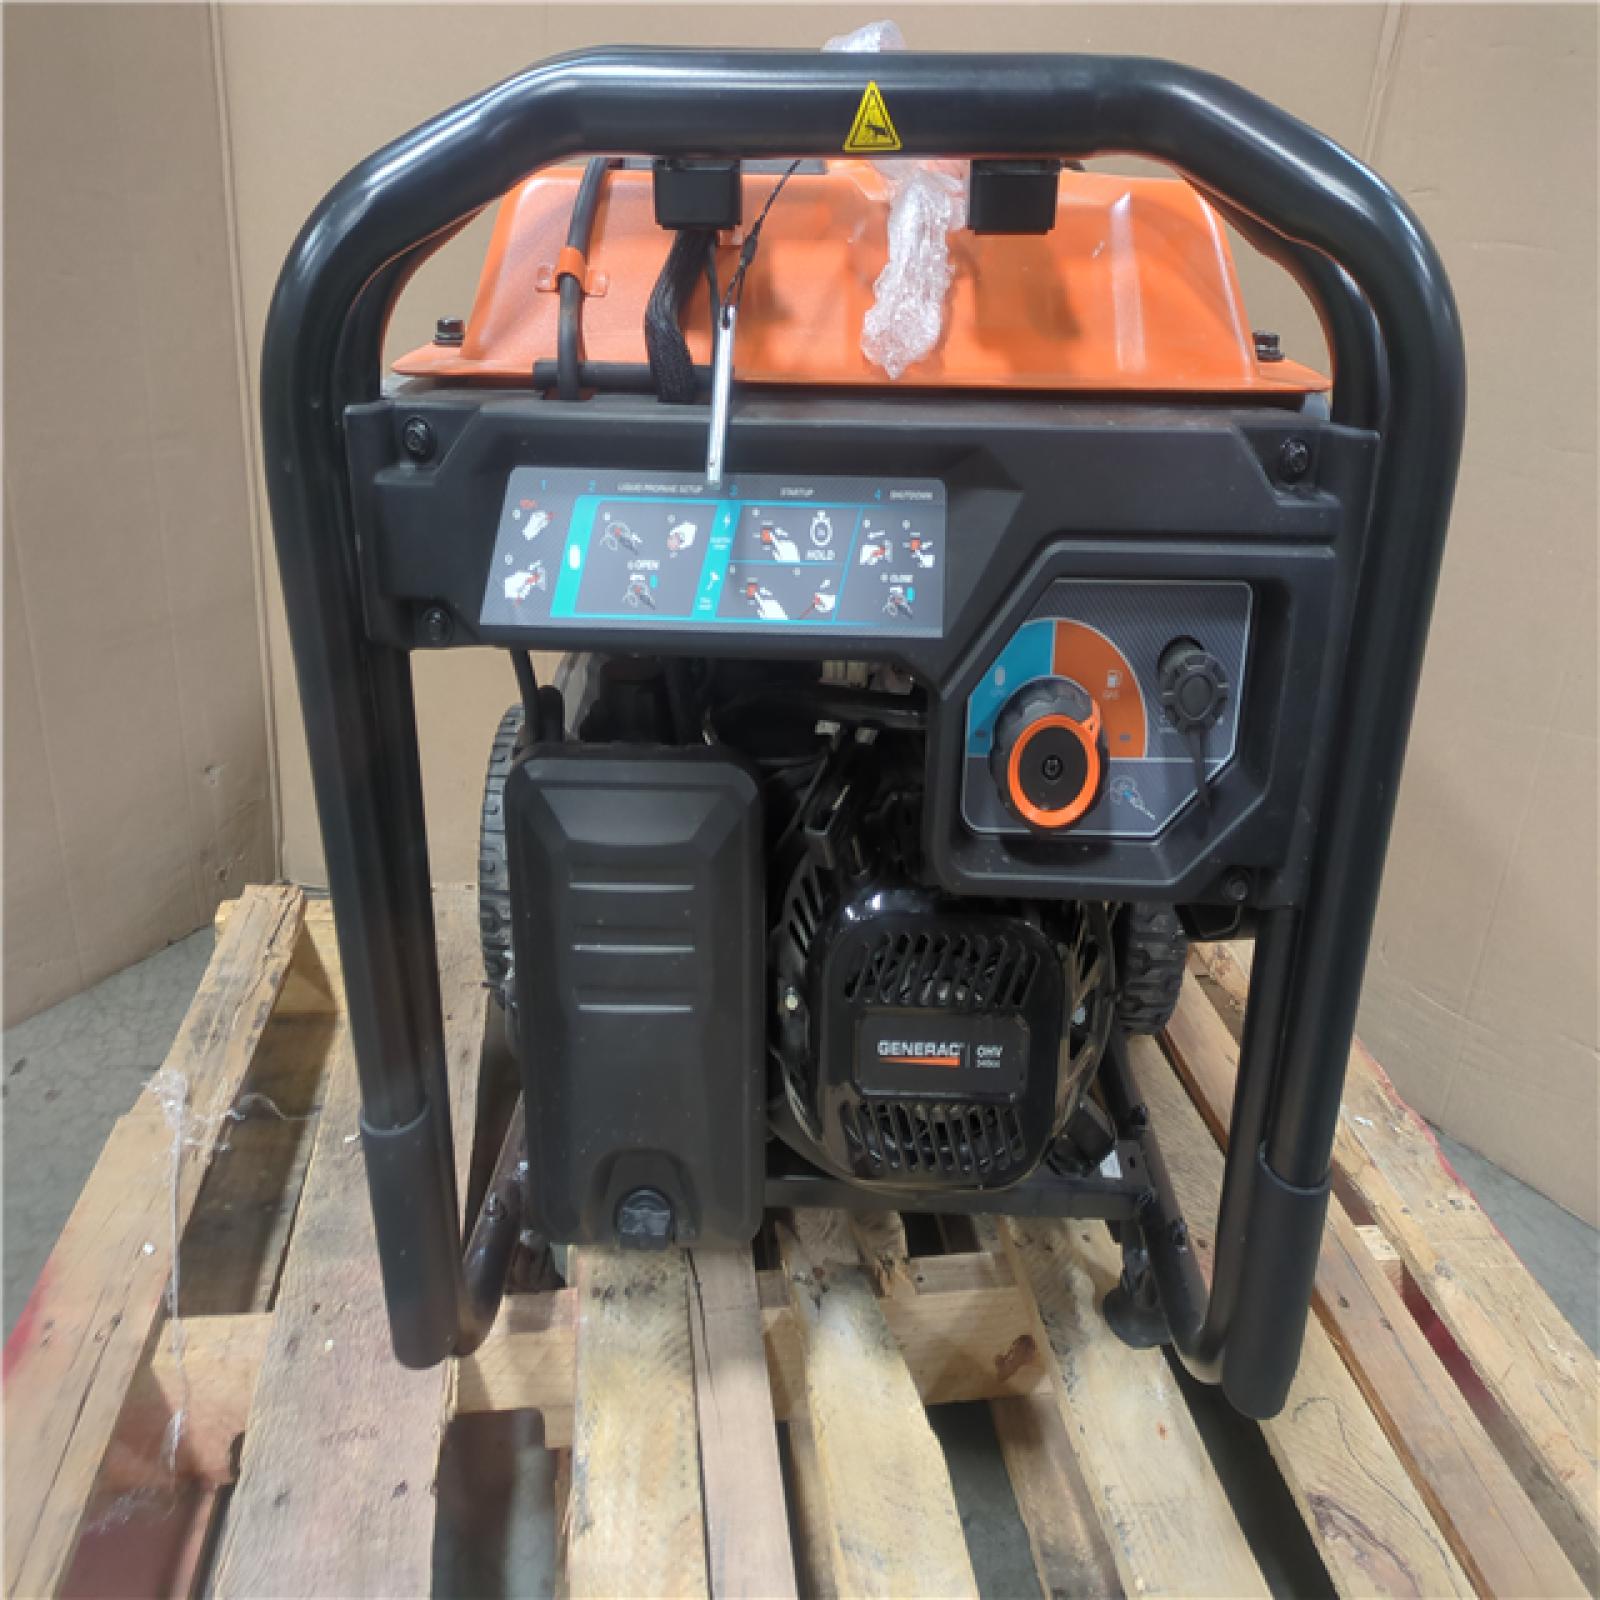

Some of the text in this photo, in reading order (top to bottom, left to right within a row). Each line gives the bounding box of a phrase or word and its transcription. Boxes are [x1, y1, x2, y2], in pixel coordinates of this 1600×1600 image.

[679, 485, 704, 494] SETUP
[780, 486, 815, 498] STARTUP
[890, 489, 934, 500] SHUTDOWN
[805, 550, 837, 561] HOLD
[633, 559, 660, 571] OPEN
[877, 1040, 961, 1057] GENERAC
[976, 1045, 1003, 1058] OHV
